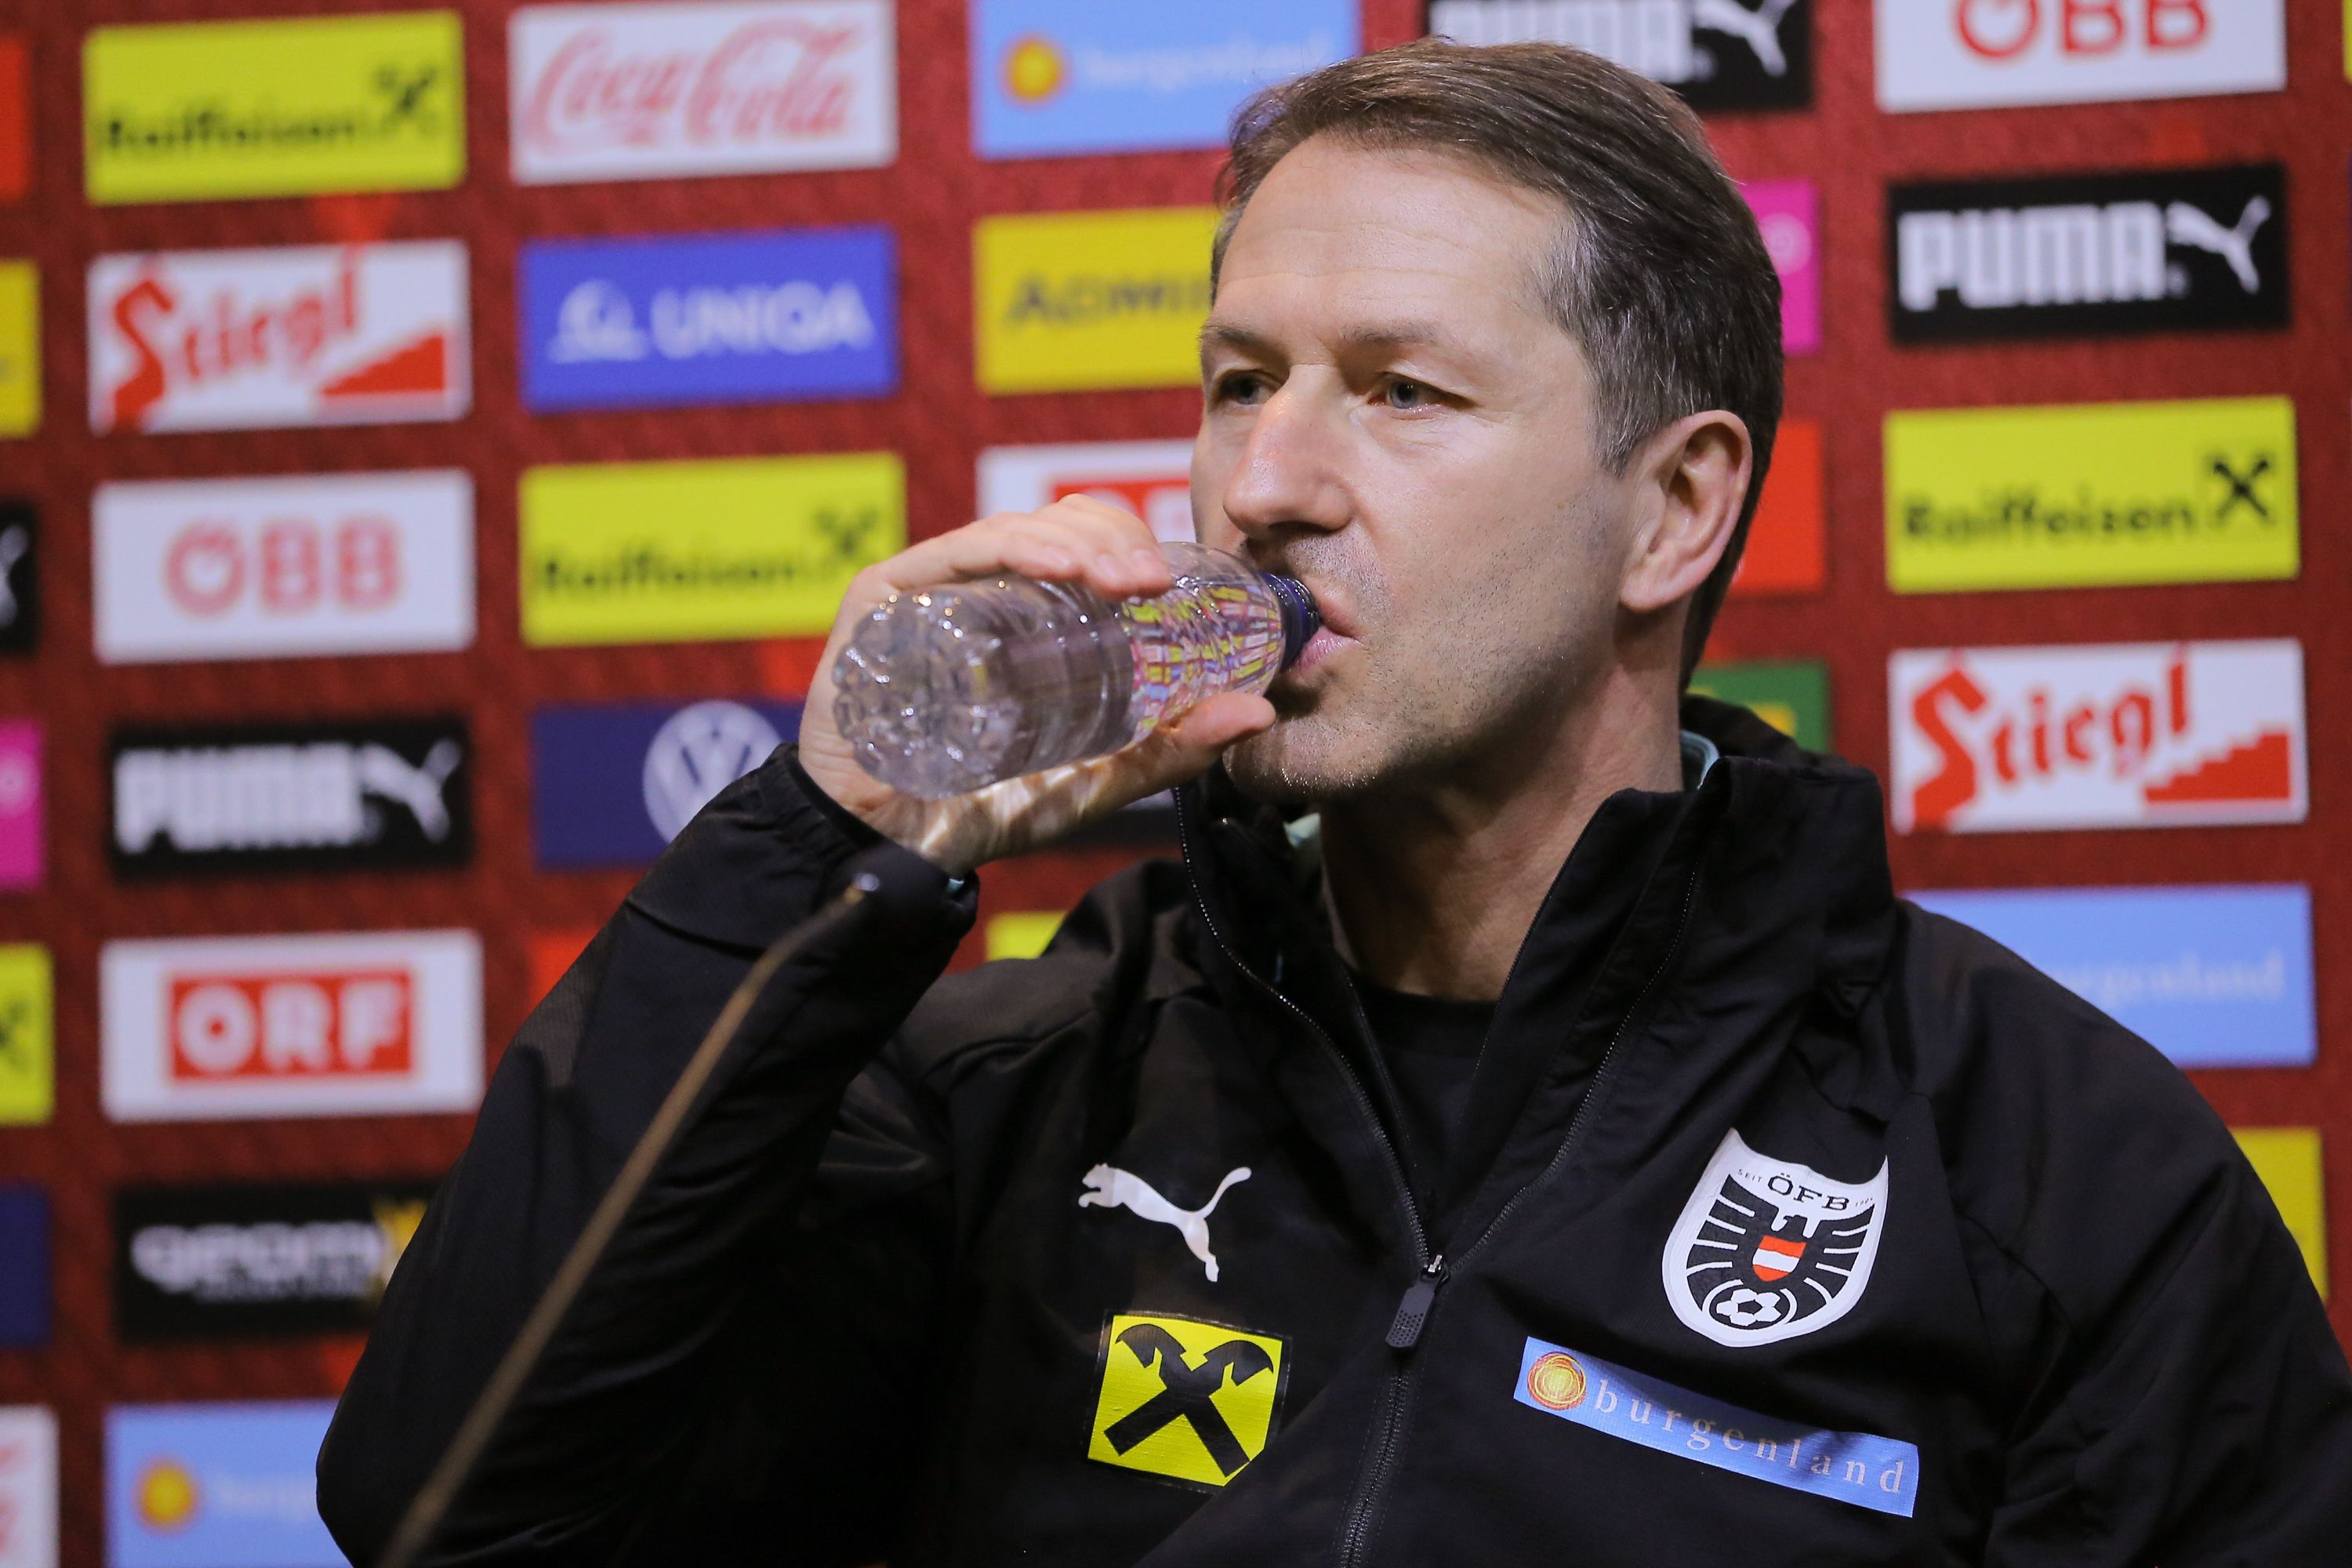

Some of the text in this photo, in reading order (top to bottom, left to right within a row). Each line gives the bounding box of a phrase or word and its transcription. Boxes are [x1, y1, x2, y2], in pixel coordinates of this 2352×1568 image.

[1897, 199, 2167, 314] PUMA
[1901, 477, 2197, 552] Raiffeisen
[1910, 648, 2190, 831] Stiegl
[114, 741, 365, 856] PUMA
[177, 980, 403, 1076] ORF
[1767, 1172, 1850, 1211] ÖFB
[1594, 1378, 1905, 1494] burgenland
